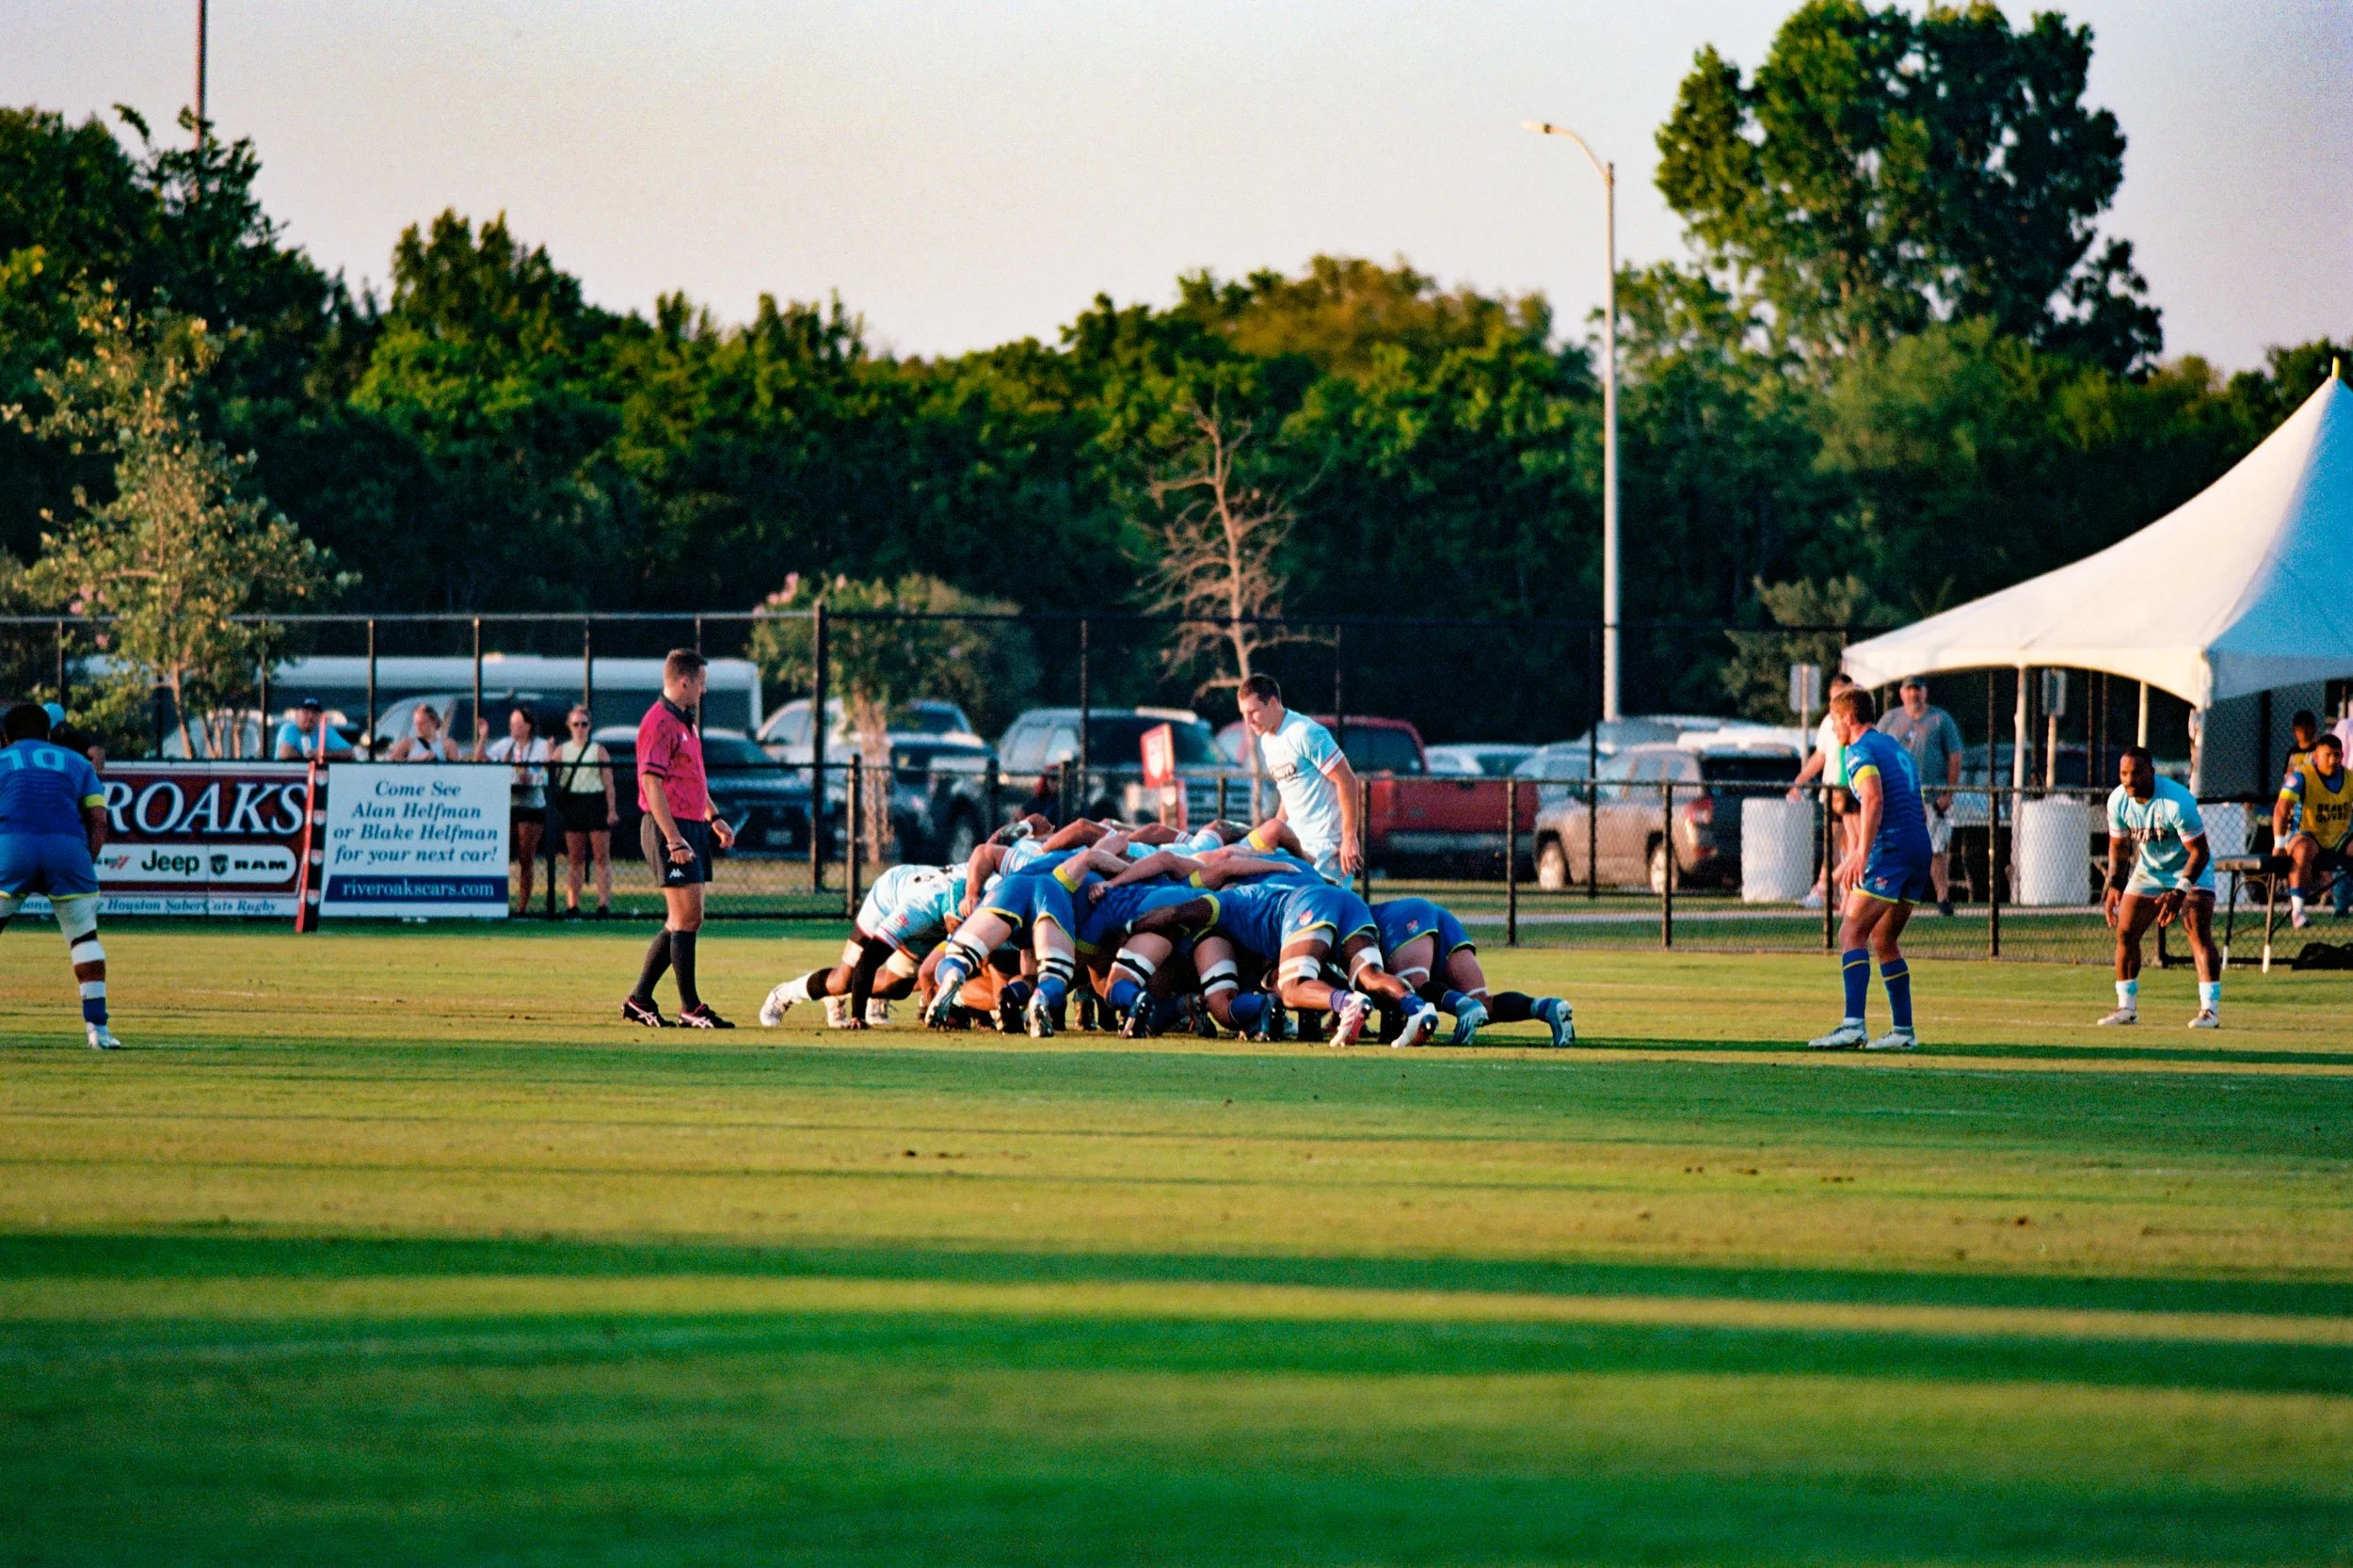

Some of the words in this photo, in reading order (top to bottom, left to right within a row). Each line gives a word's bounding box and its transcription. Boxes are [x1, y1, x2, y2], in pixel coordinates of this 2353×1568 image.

[1897, 751, 1914, 792] 9
[376, 780, 425, 796] Come
[431, 780, 461, 796] See
[351, 802, 395, 818] Alan
[402, 802, 482, 822] Helfman
[333, 826, 354, 840] or
[360, 824, 414, 840] Blake
[420, 824, 498, 843] Helfman
[142, 850, 200, 875] Jeep
[234, 859, 287, 870] RAM
[334, 845, 362, 865] for
[367, 851, 410, 865] your
[416, 848, 455, 861] next
[460, 846, 498, 861] car!
[342, 878, 495, 896] riveroakscars.com
[107, 899, 162, 911] Houston
[237, 899, 276, 913] Rugby
